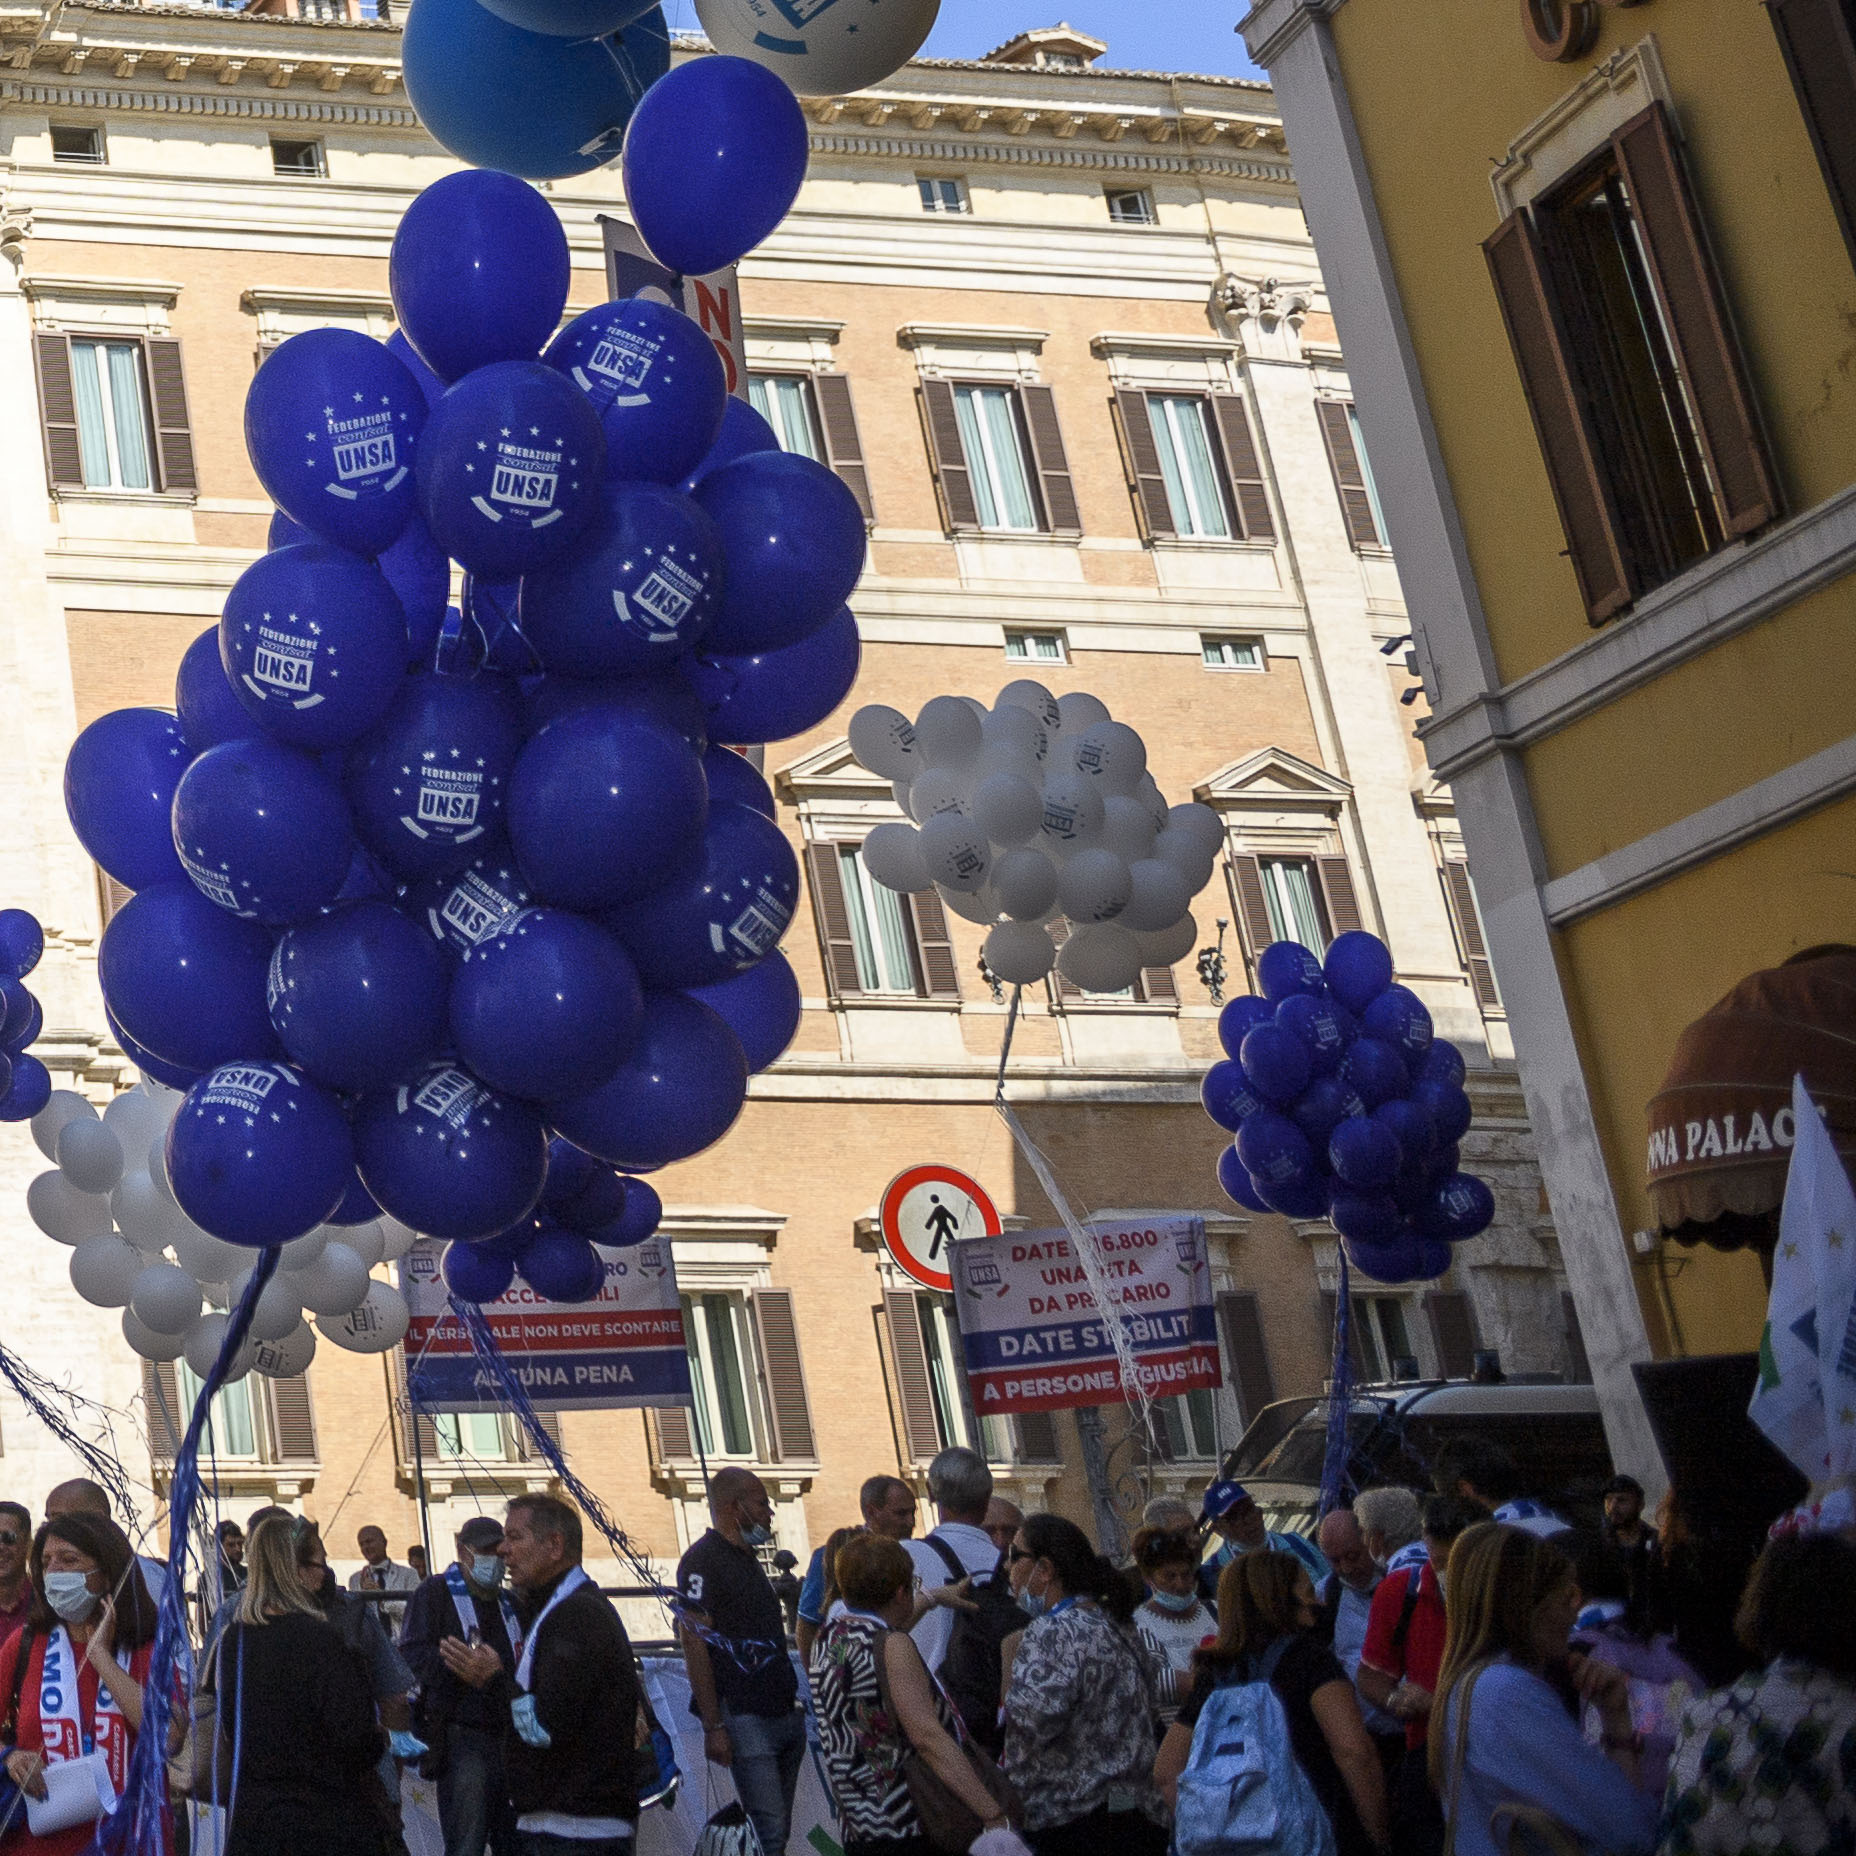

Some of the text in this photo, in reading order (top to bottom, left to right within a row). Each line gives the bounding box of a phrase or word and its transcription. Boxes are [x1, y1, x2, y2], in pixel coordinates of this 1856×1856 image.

[593, 344, 651, 384] UNSA
[328, 411, 392, 435] FEDERAZIONE
[337, 436, 393, 475] UNSA
[498, 442, 562, 463] FEDERAZIONE
[495, 469, 555, 502] UNSA
[640, 579, 690, 625] UNSA
[259, 625, 318, 650] FEDERAZIONE
[256, 652, 310, 687] UNSA
[421, 766, 483, 783] FEDERAZIONE
[422, 790, 476, 821] UNSA
[446, 898, 488, 935] UNS
[212, 1070, 272, 1095] UNSA
[1011, 1240, 1071, 1262] DATE
[1040, 1263, 1089, 1285] UNA
[1029, 1296, 1061, 1315] DA
[409, 1319, 681, 1341] IL NON DEVE SCONTARE
[998, 1328, 1080, 1358] DATE
[574, 1364, 634, 1385] PENA
[983, 1370, 1115, 1401] A PERSONE
[686, 1571, 704, 1600] 3
